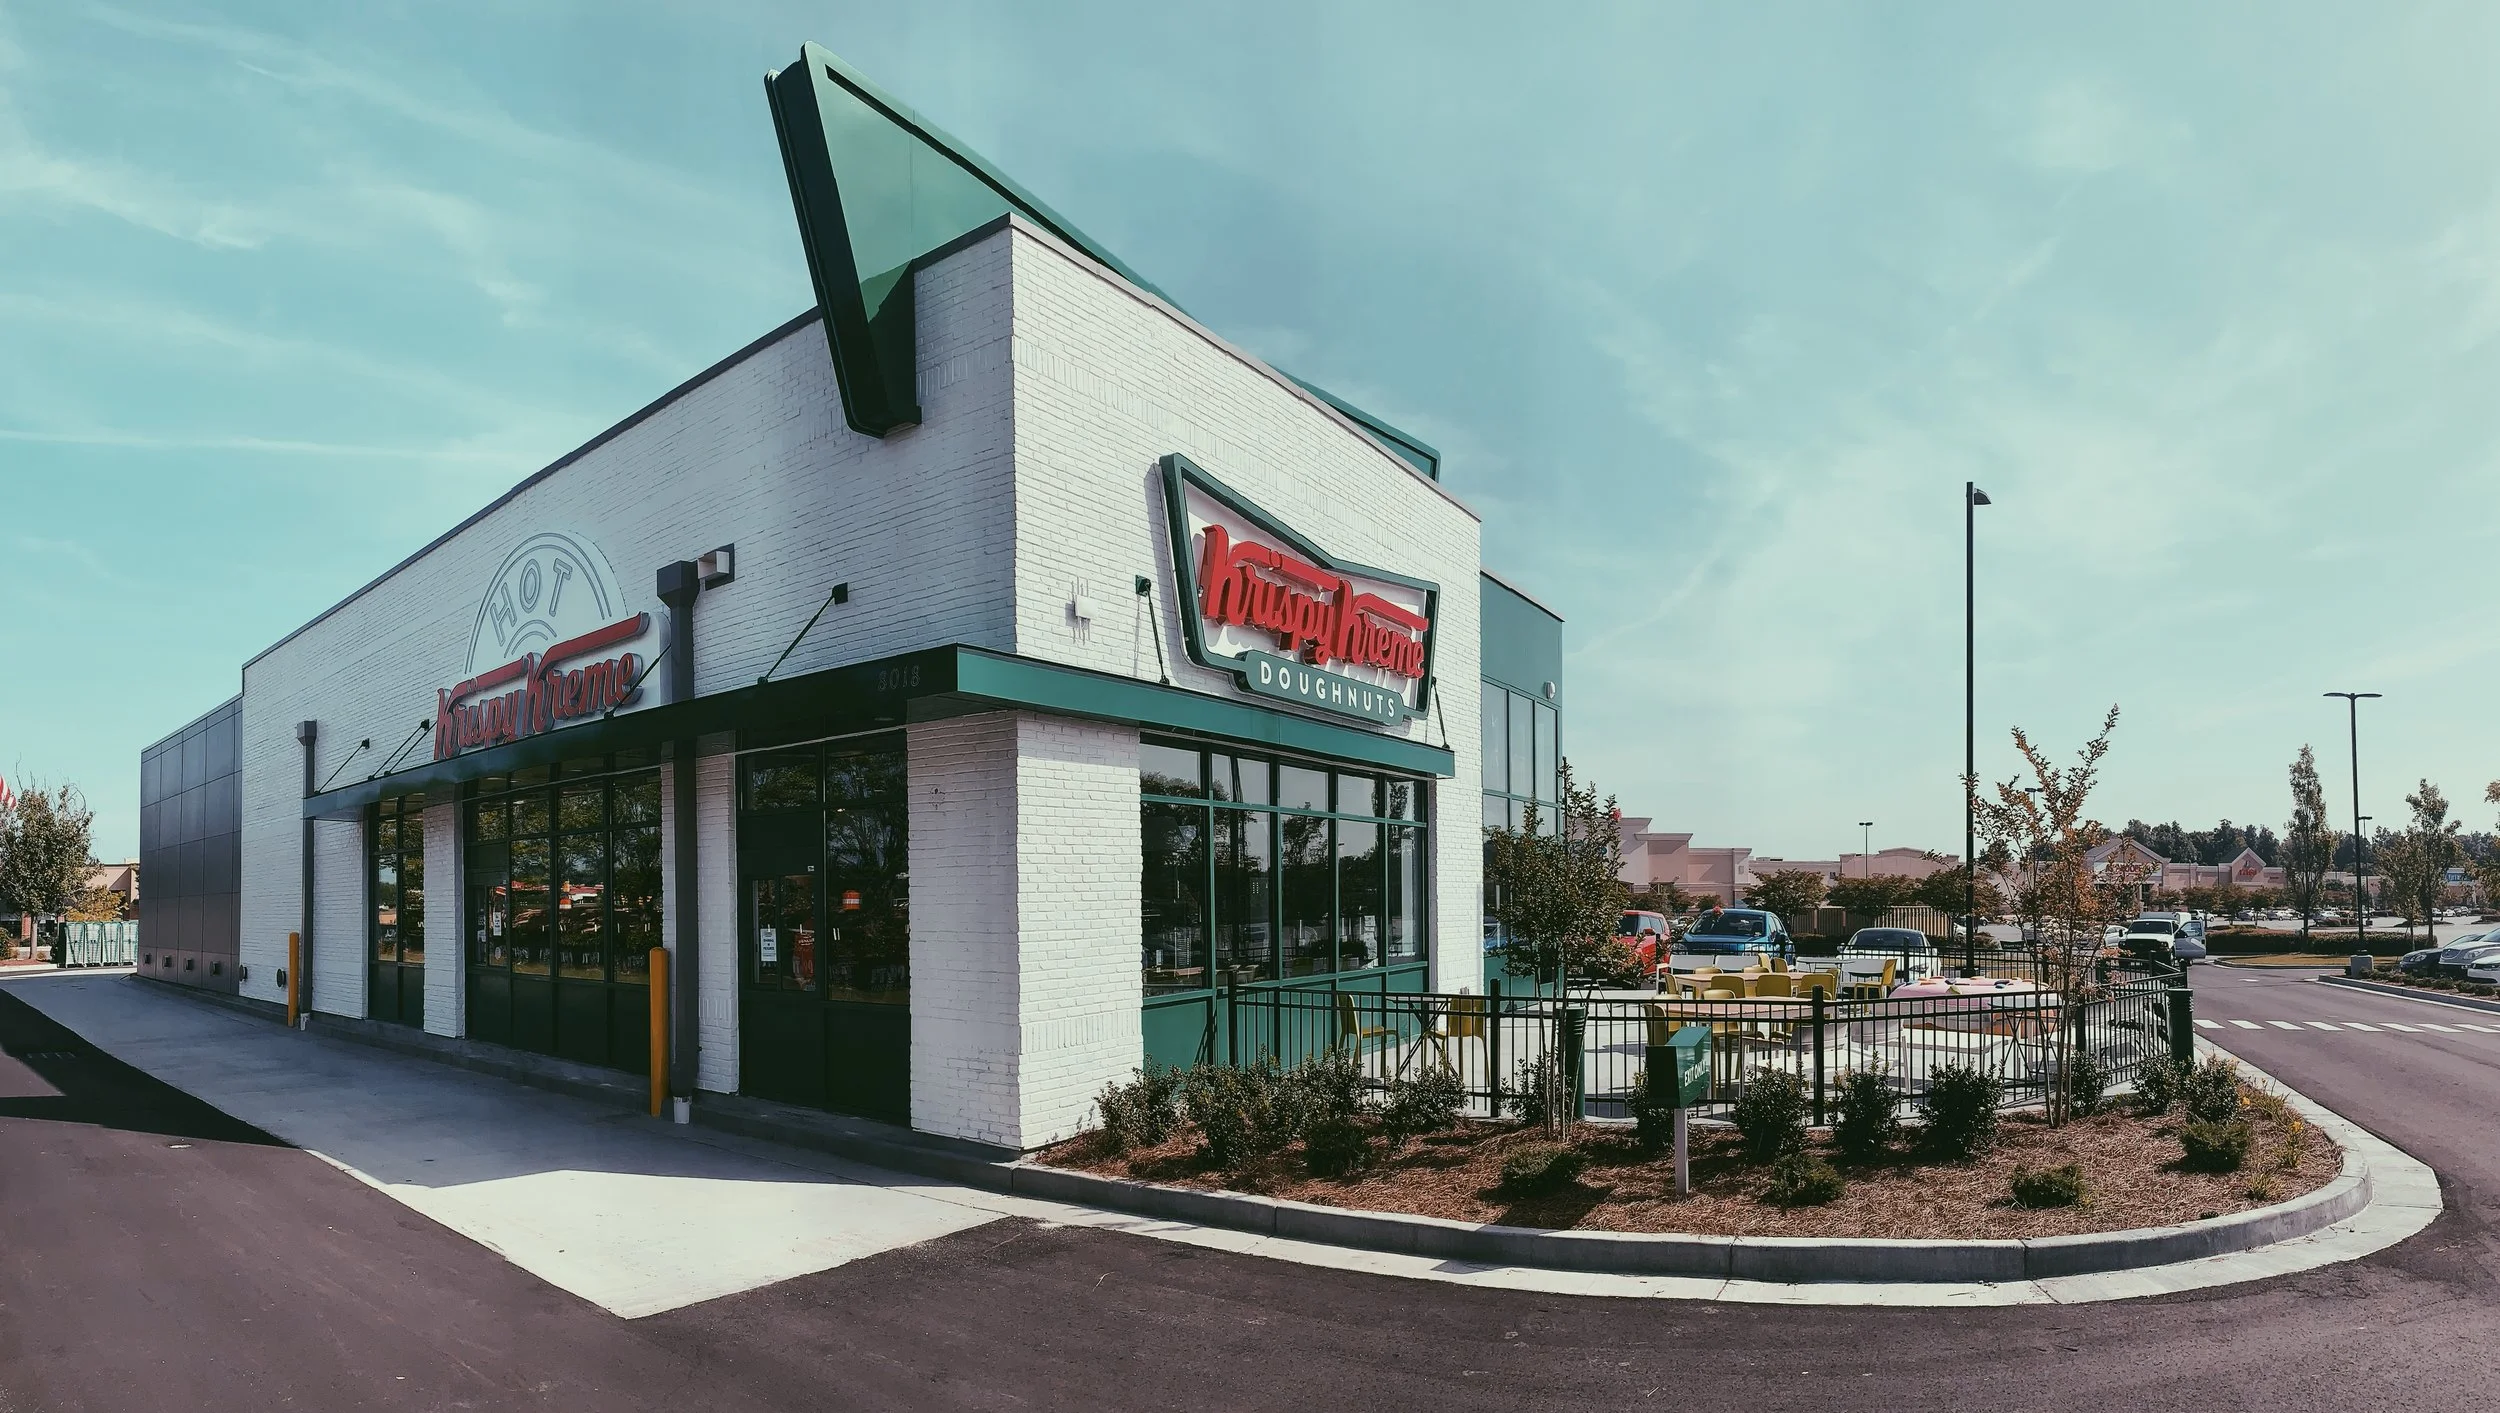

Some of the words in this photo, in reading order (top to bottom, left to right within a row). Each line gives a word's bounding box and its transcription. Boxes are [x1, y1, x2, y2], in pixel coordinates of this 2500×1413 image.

[489, 558, 573, 647] HOT
[1201, 524, 1339, 665] Krispy
[1335, 579, 1429, 679] Kreme
[434, 655, 528, 761] Krispy
[522, 611, 650, 735] Kreme
[1259, 660, 1396, 718] DOUGHNUTS
[1684, 1067, 1694, 1087] EXIT
[1694, 1059, 1706, 1080] ONLY
